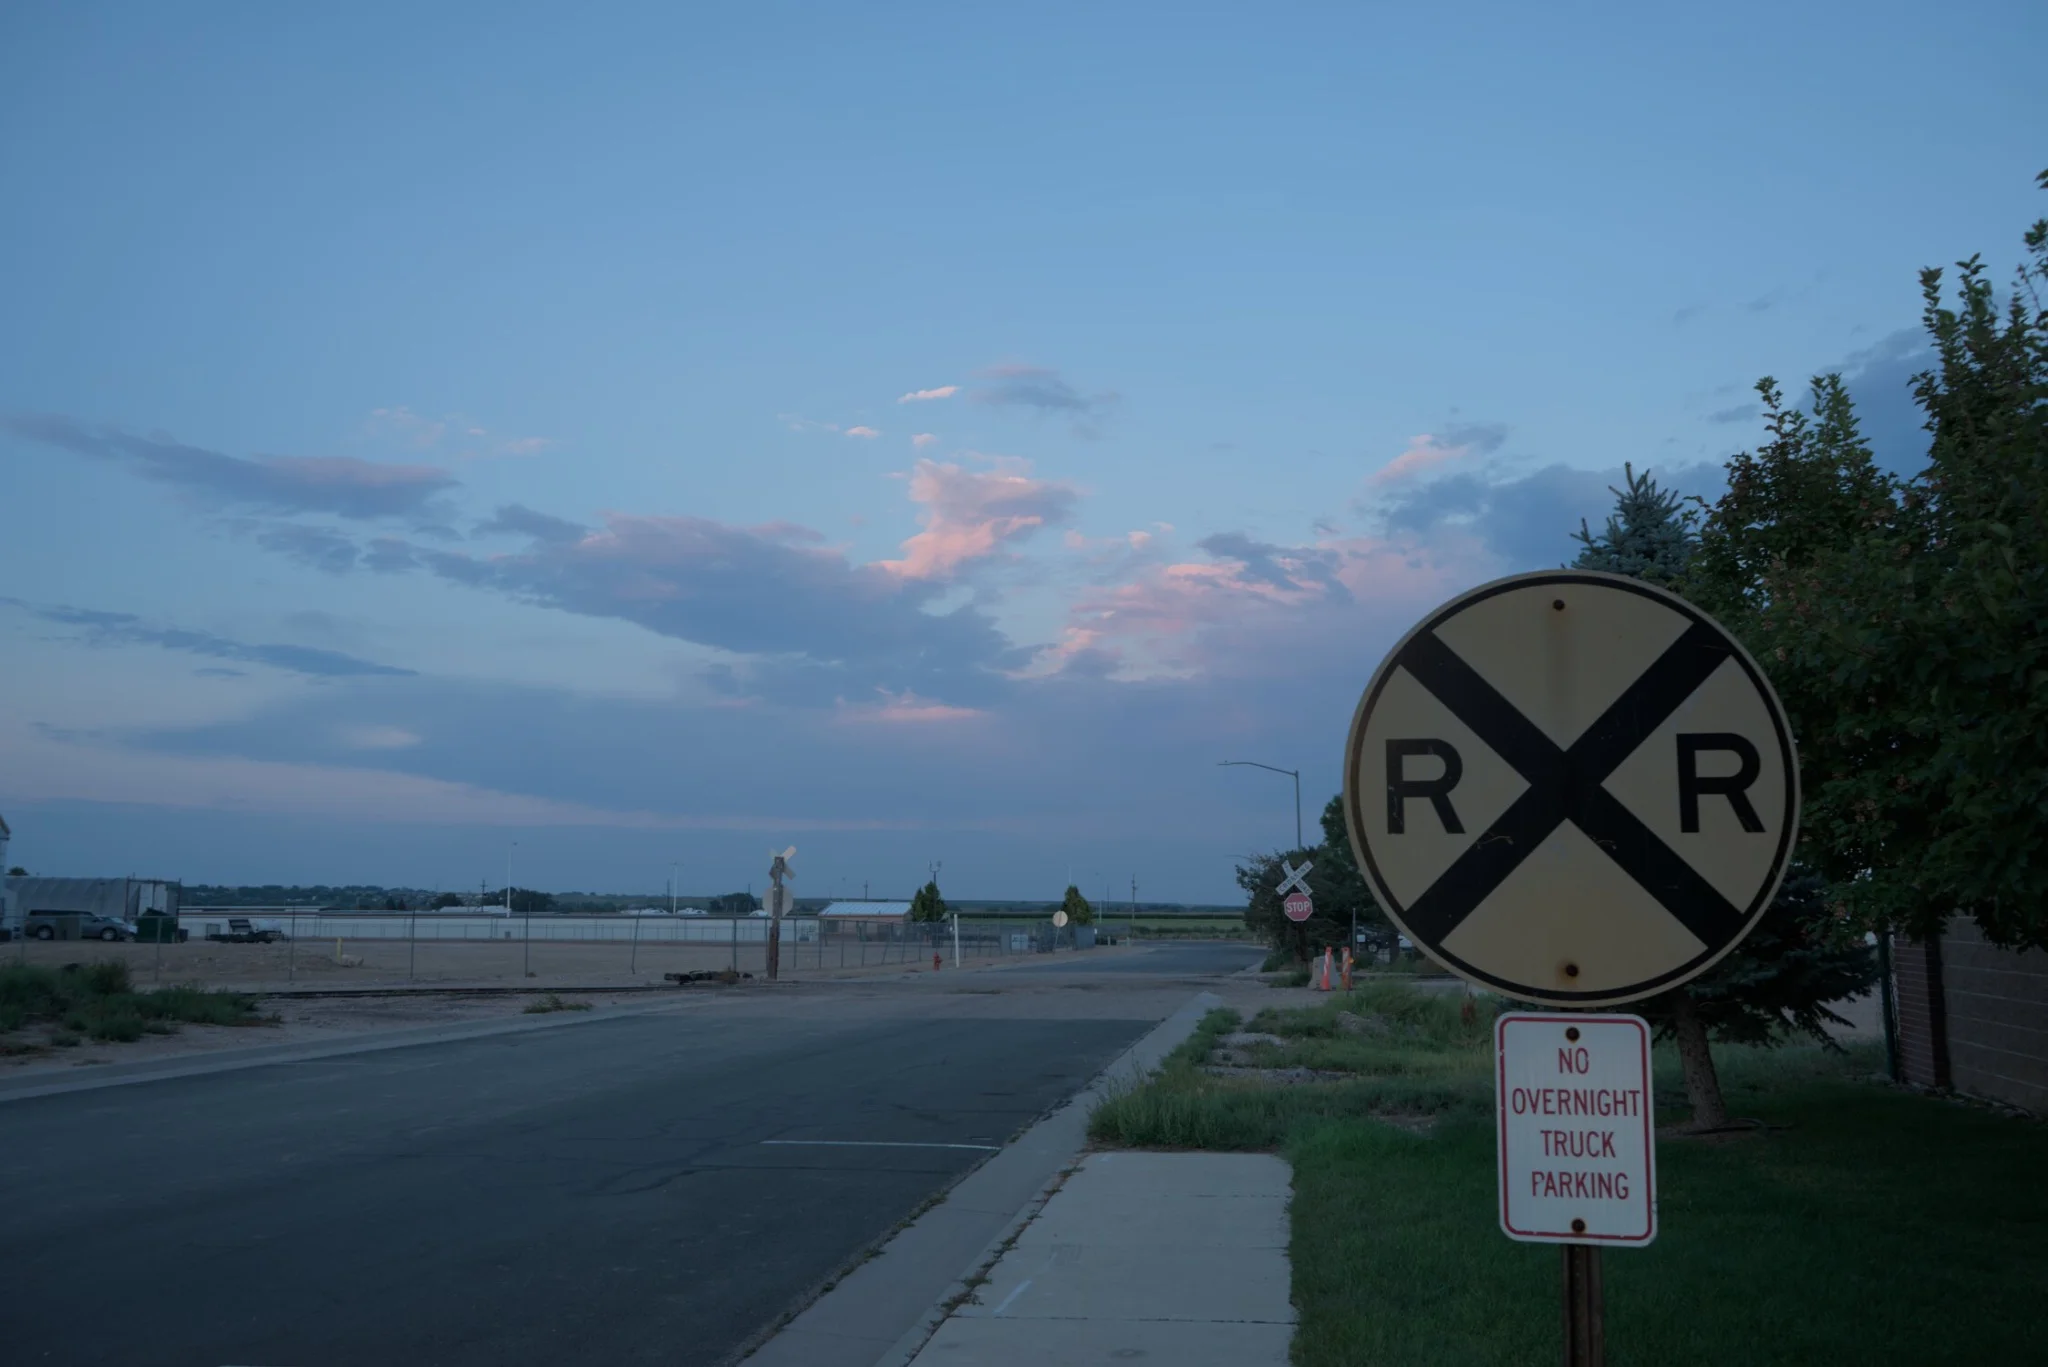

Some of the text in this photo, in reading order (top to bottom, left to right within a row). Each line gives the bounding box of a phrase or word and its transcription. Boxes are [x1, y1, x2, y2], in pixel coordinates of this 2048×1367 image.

[1385, 731, 1768, 835] R R
[1286, 901, 1310, 913] STOP
[1558, 1047, 1589, 1074] NO
[1512, 1087, 1641, 1117] OVERNIGHT
[1539, 1129, 1617, 1158] TRUCK
[1531, 1170, 1630, 1200] PARKING
